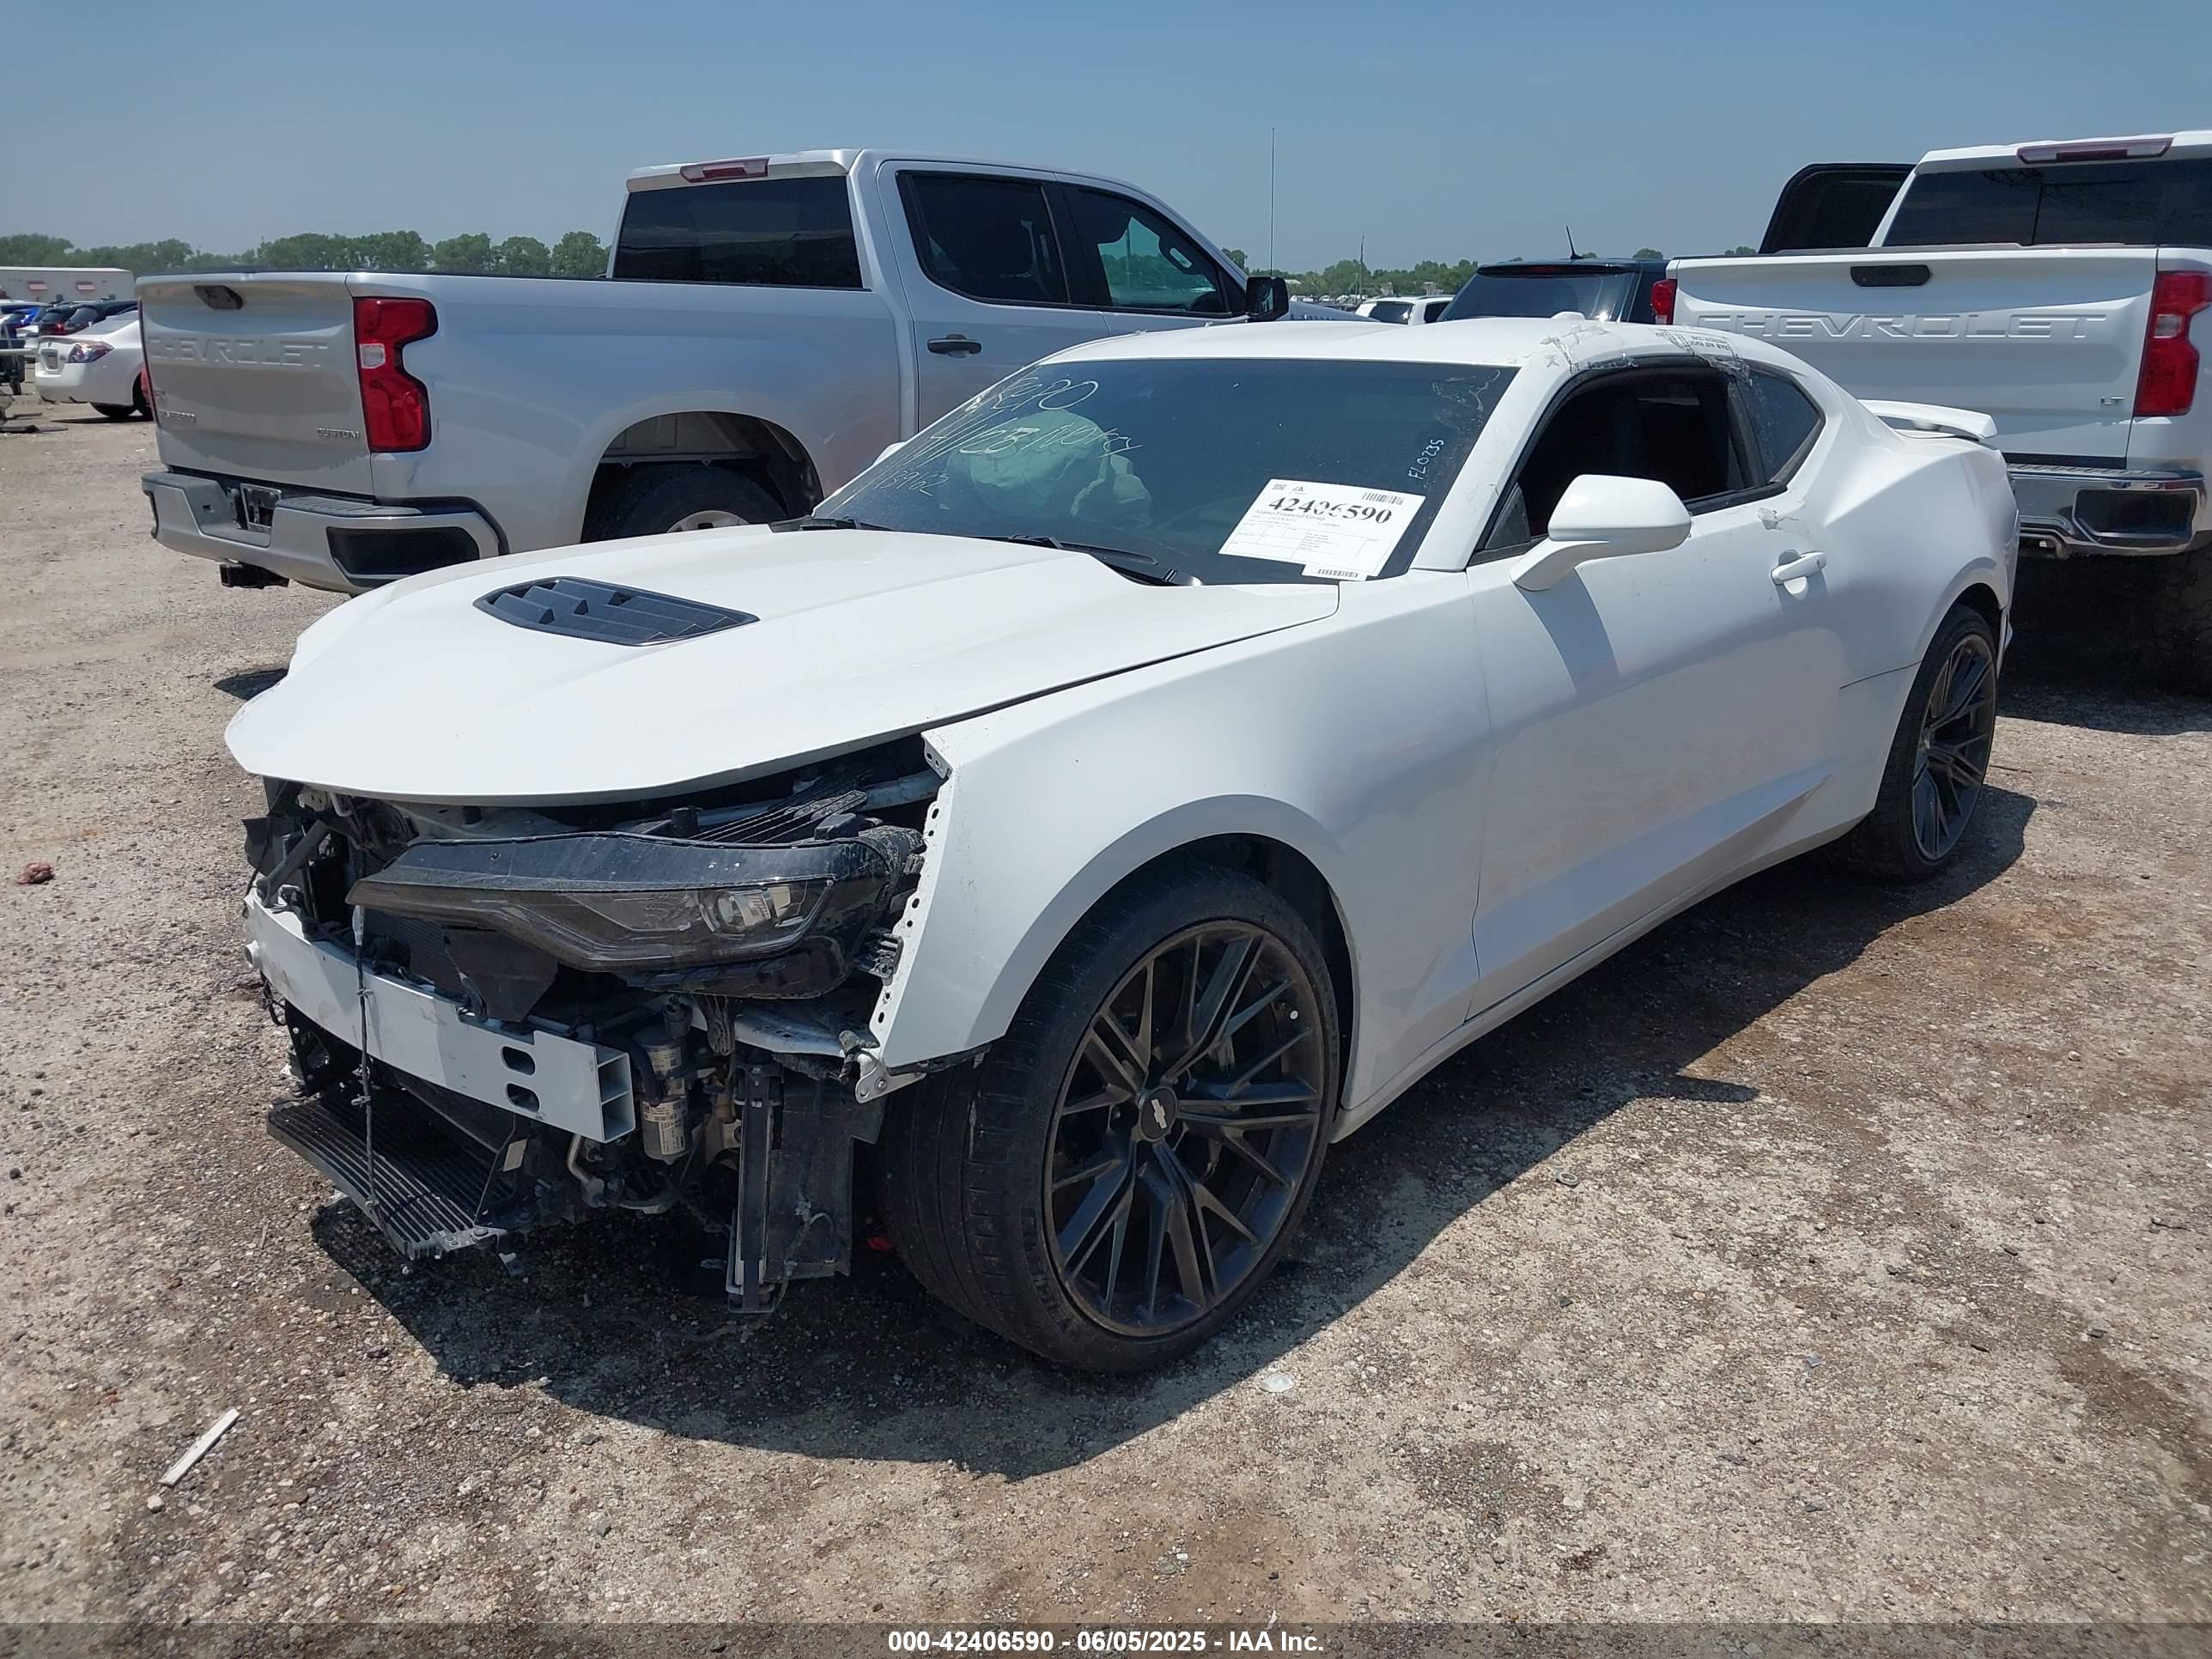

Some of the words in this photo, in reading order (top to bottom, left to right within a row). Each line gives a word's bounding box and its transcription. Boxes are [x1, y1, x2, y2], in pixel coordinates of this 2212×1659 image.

[1698, 313, 2107, 338] CHEVROLET
[149, 336, 329, 368] CHEVROLET
[2100, 397, 2125, 406] LT
[1268, 496, 1393, 525] 42406590
